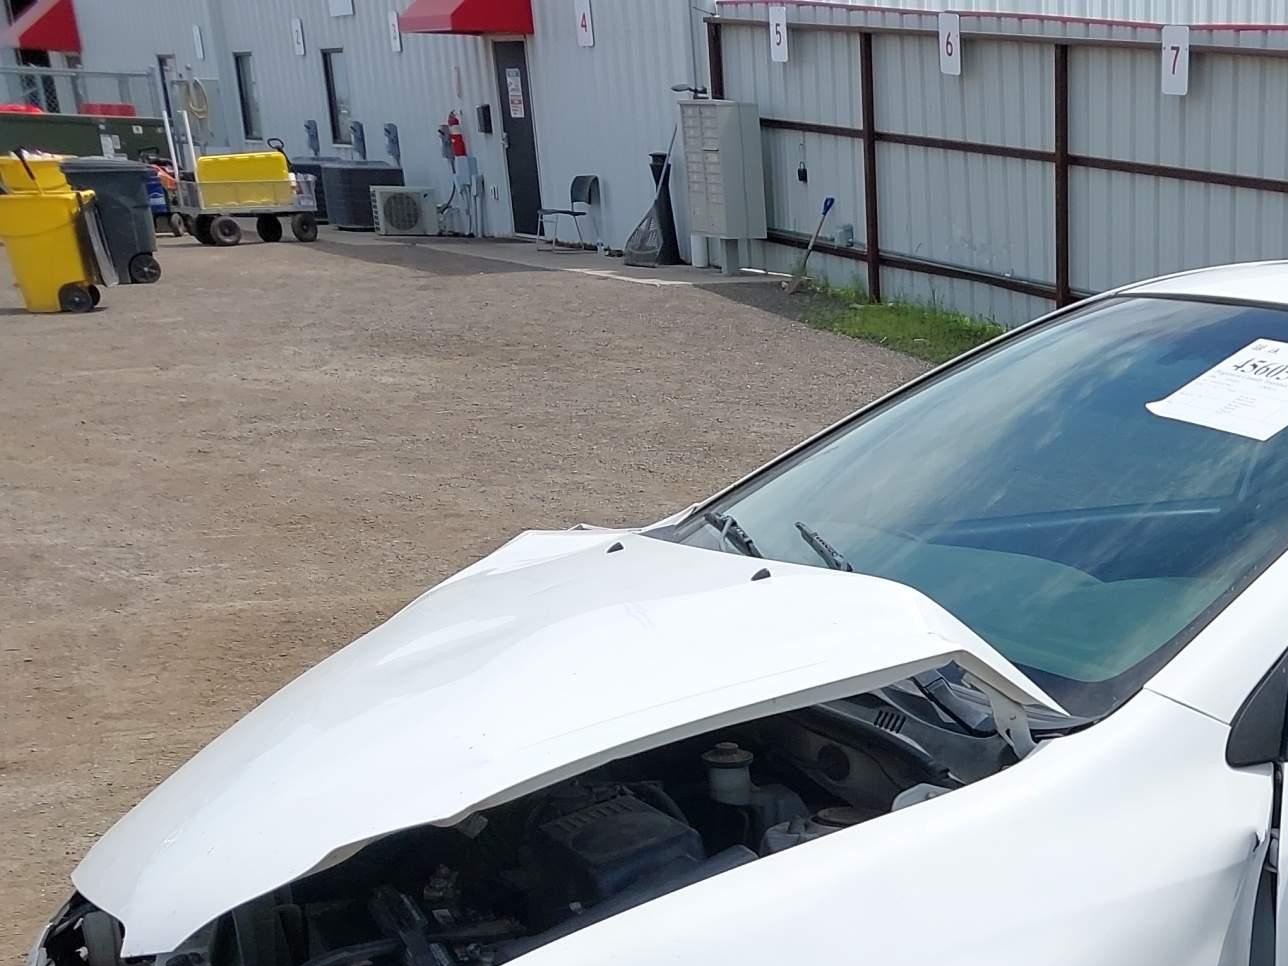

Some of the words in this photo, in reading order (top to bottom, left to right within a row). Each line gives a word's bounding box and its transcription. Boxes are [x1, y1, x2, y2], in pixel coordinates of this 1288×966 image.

[580, 12, 588, 33] 4
[775, 22, 782, 46] 5
[945, 31, 954, 57] 6
[1170, 46, 1181, 75] 7
